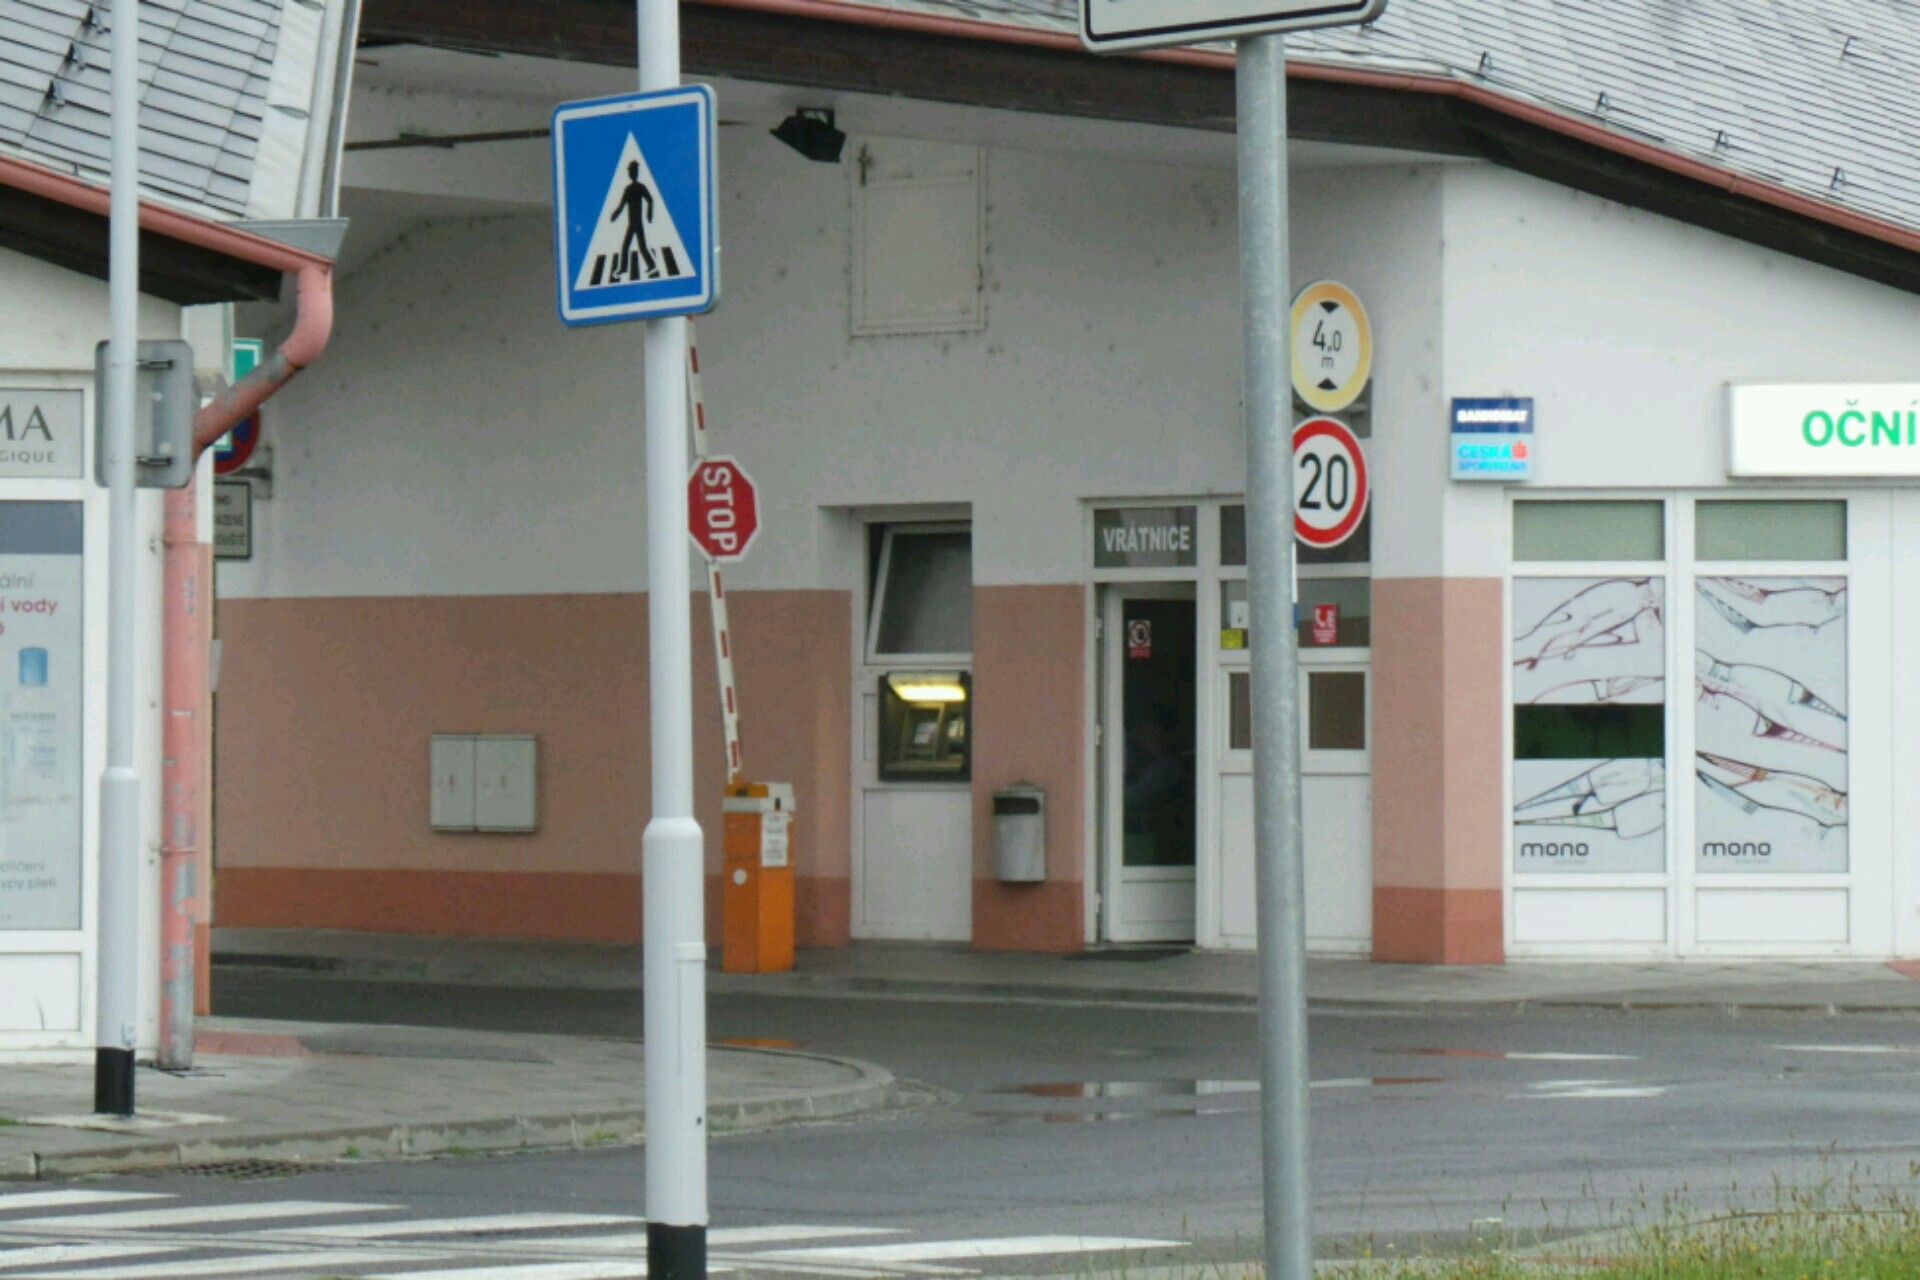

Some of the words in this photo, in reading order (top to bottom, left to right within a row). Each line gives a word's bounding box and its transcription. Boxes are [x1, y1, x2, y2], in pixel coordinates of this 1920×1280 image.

[1312, 320, 1342, 352] 4,0
[1321, 356, 1334, 368] m
[1802, 399, 1919, 447] OČNÍ
[1299, 452, 1349, 511] 20
[703, 467, 738, 551] STOP
[1103, 522, 1190, 552] VRÁTNICE
[11, 597, 58, 616] vody
[1520, 842, 1590, 857] mono
[1702, 841, 1772, 857] mono
